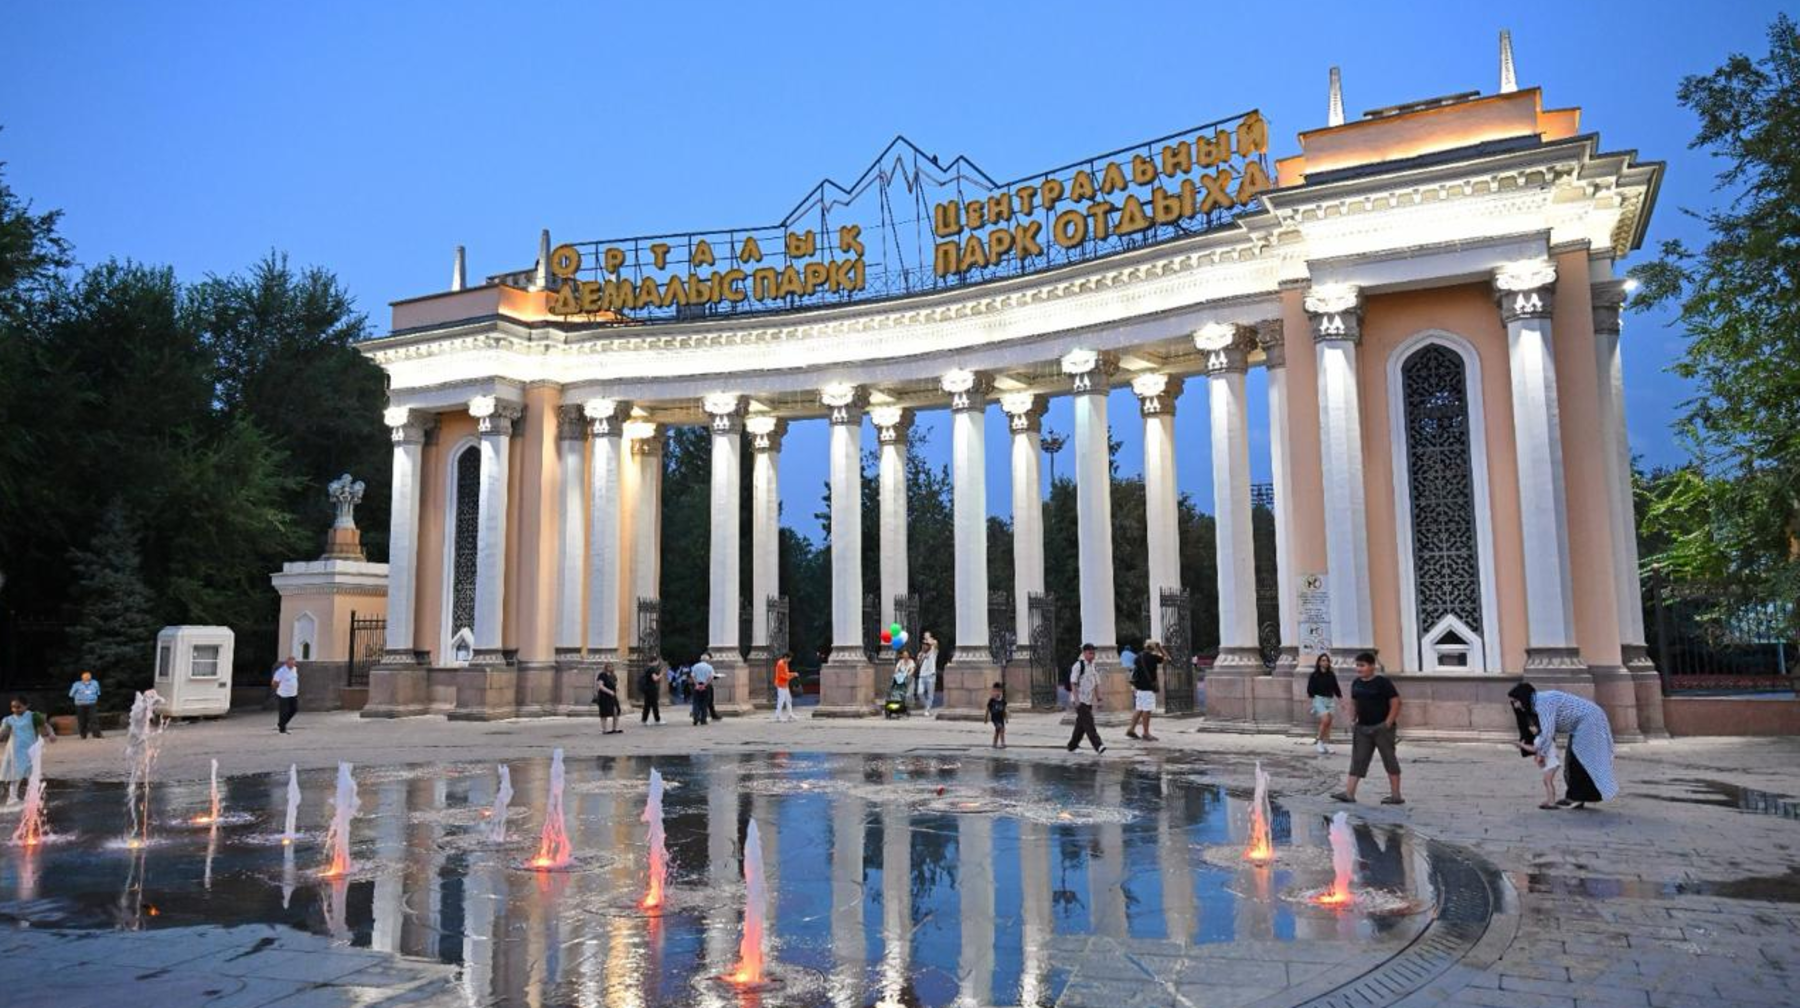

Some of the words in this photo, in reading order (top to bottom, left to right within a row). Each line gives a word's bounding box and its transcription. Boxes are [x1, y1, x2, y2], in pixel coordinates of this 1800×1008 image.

[934, 113, 1268, 237] ЦЕНТРАЛЬНЫЙ
[551, 225, 864, 277] ОРТАЛЫҚ
[934, 220, 1042, 278] ПАРК
[1053, 160, 1271, 248] ОТДЫХА
[549, 269, 747, 314] ДЕМАЛЫС
[753, 257, 865, 300] ПАРКІ
